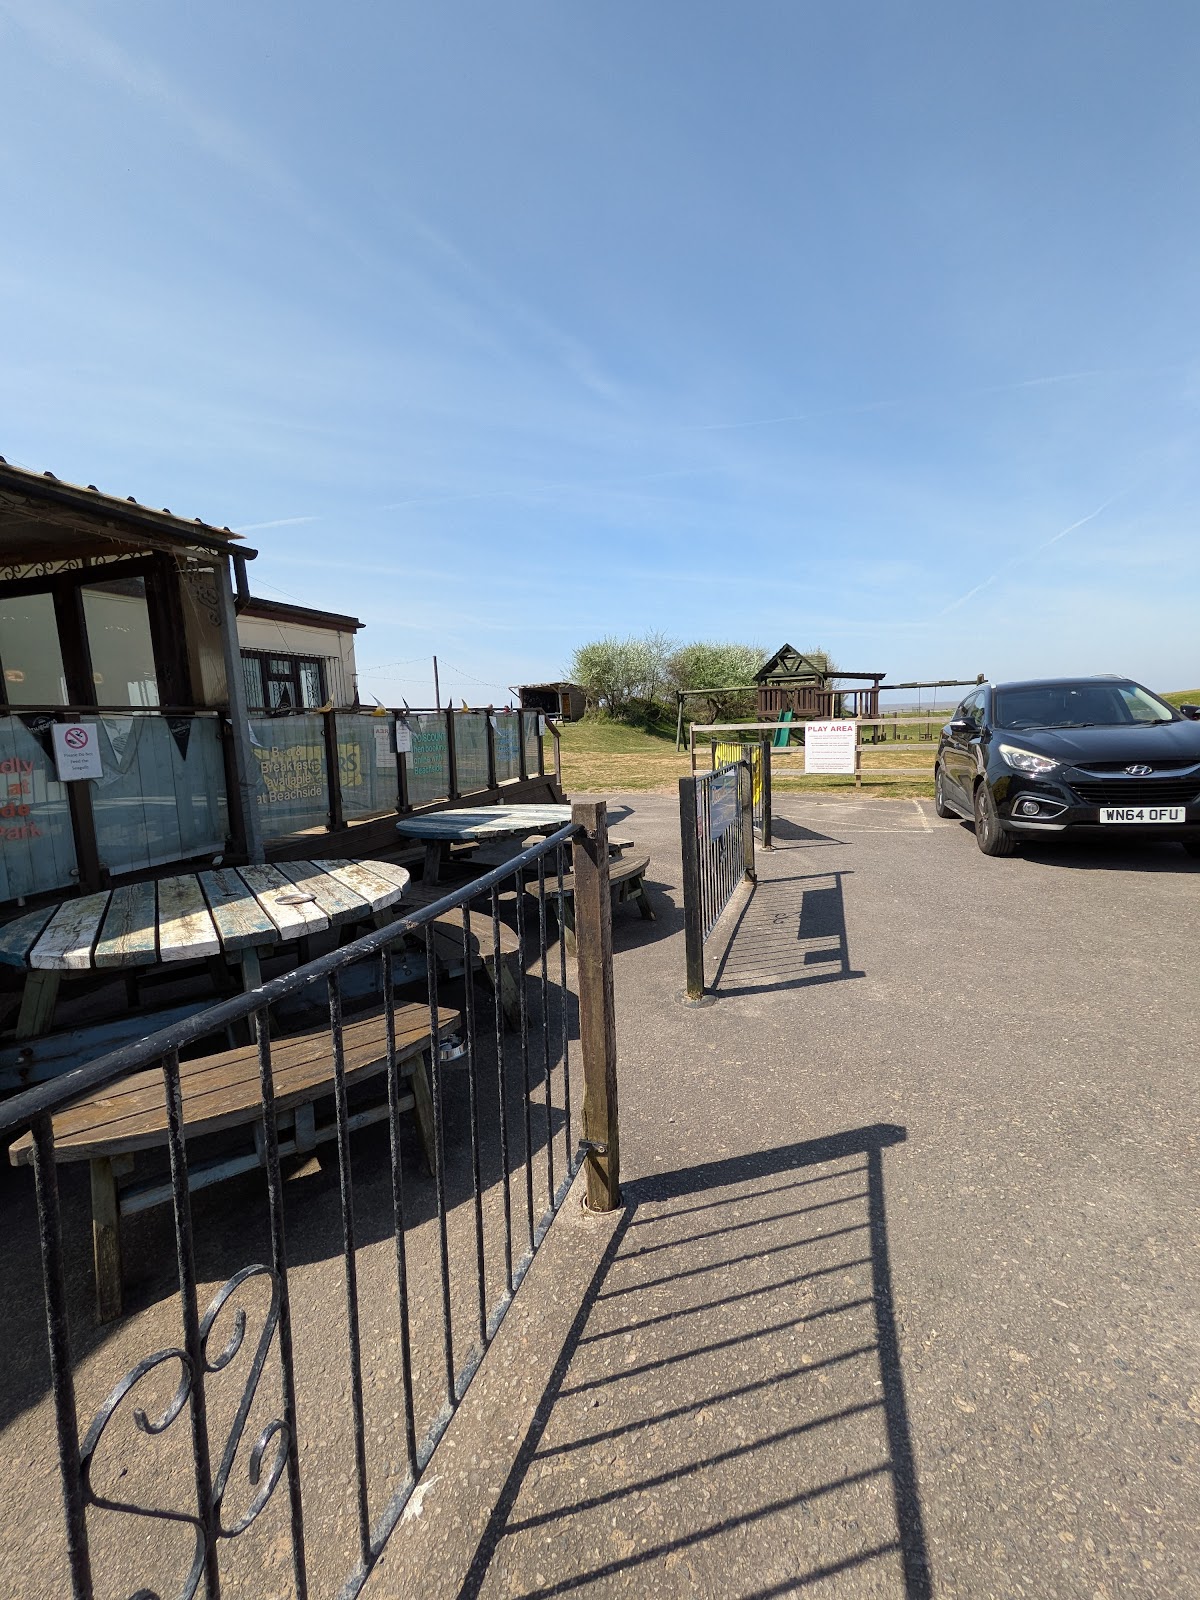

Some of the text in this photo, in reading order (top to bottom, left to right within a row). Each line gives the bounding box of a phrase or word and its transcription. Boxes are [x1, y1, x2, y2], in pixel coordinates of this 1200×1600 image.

[261, 760, 312, 774] Breakfast
[8, 779, 31, 795] at
[267, 773, 312, 788] available
[256, 785, 322, 805] at Beachside
[1106, 809, 1178, 821] WN64 OFU
